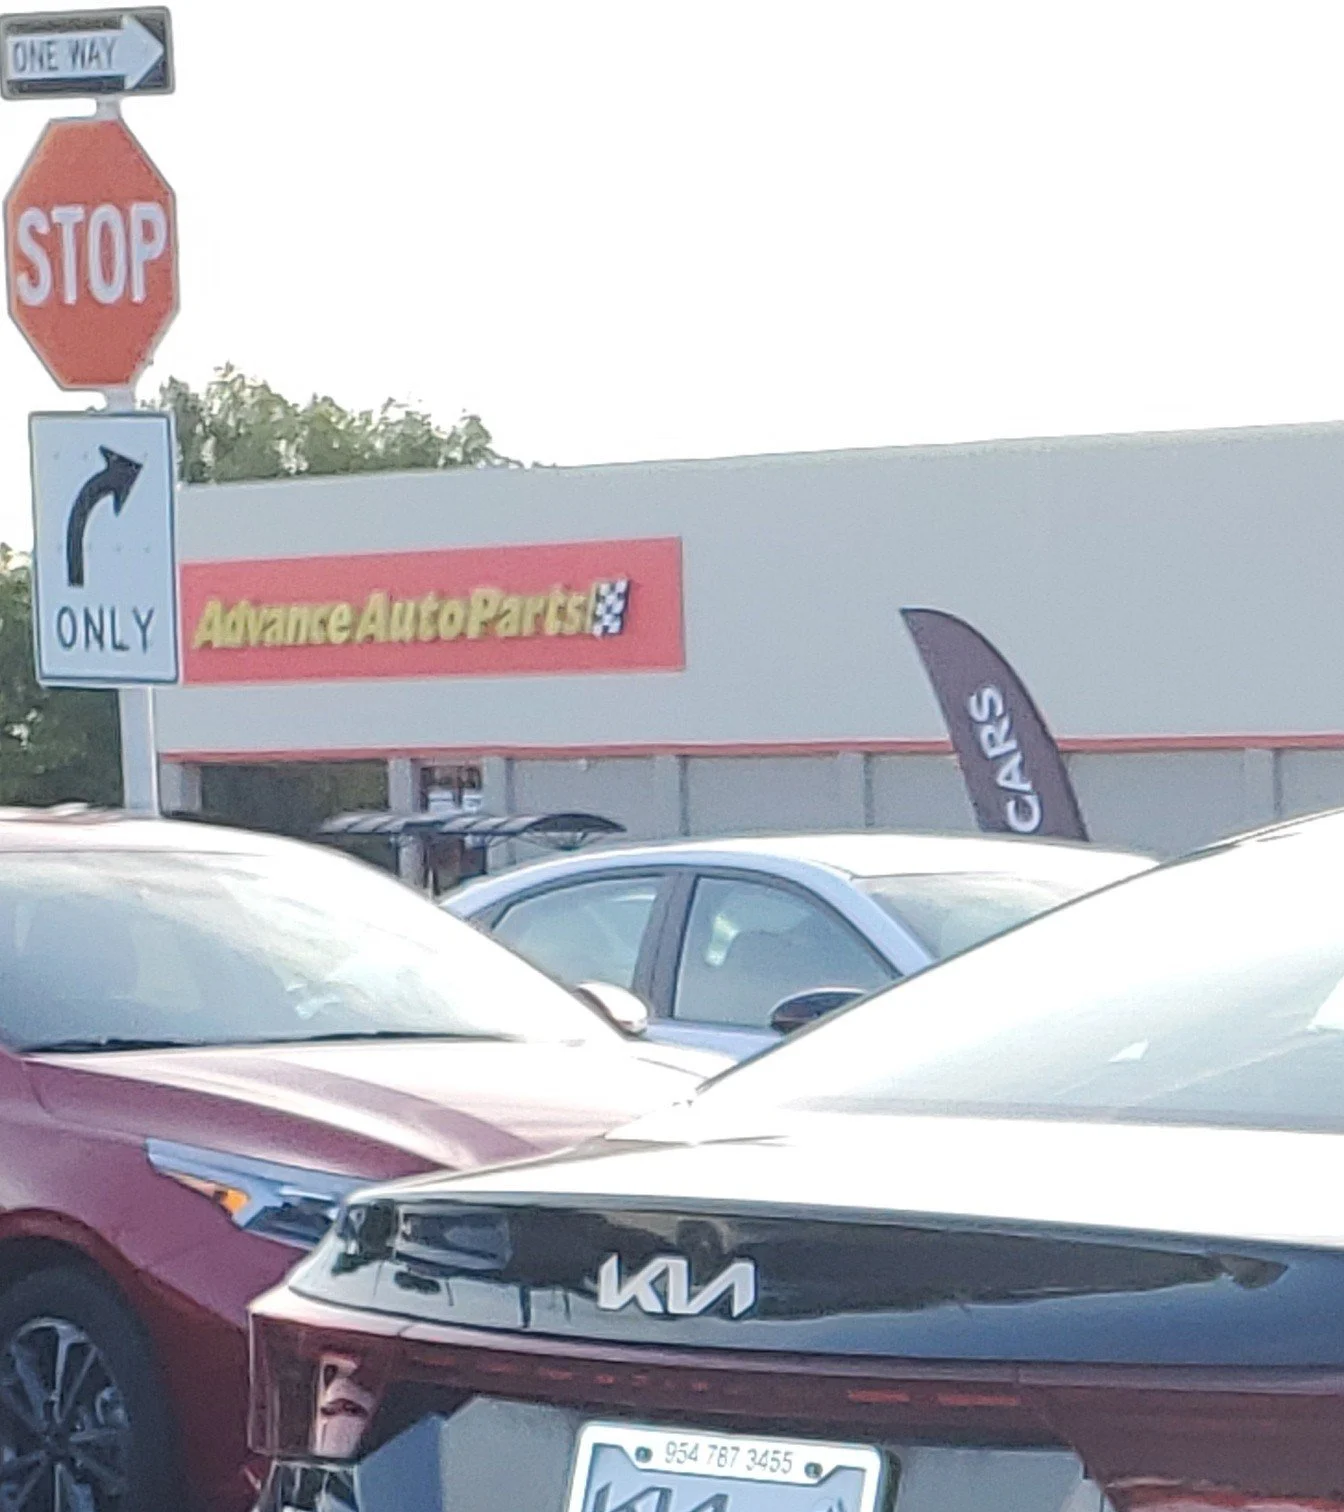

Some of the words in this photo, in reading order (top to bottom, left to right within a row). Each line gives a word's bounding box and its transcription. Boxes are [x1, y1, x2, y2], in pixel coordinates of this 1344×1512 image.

[13, 40, 59, 72] ONE
[68, 37, 118, 70] WAY
[16, 201, 168, 306] STOP
[57, 605, 155, 654] ONLY
[193, 597, 352, 649] Advance
[968, 686, 1042, 834] CARS
[598, 1252, 756, 1319] KIA
[664, 1441, 699, 1465] 954
[706, 1444, 741, 1468] 787
[745, 1448, 794, 1475] 3455
